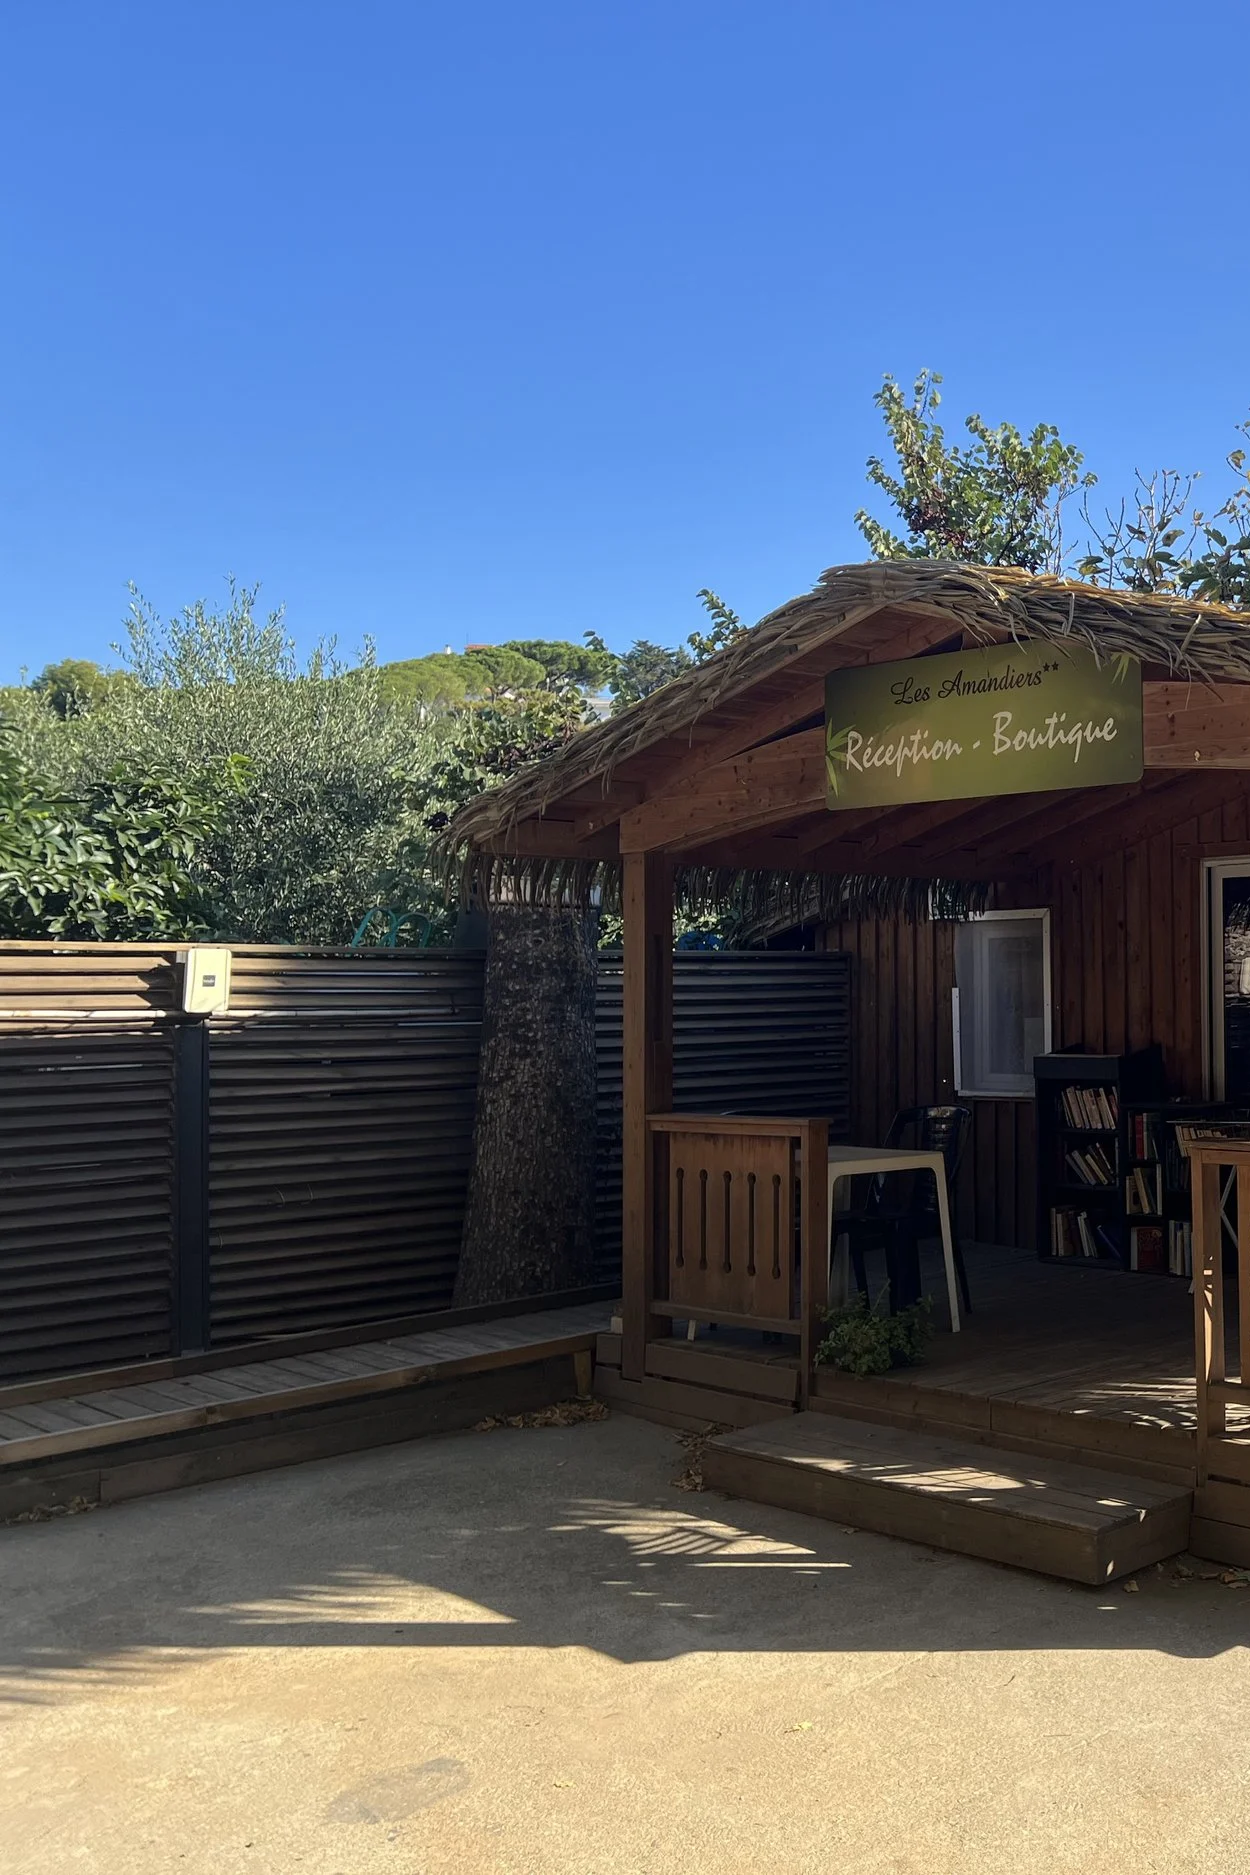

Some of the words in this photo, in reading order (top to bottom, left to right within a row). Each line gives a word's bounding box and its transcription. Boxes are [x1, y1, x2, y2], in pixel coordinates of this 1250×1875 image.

[890, 677, 930, 704] Les
[846, 729, 963, 777] Réception
[993, 711, 1117, 763] Boutique
